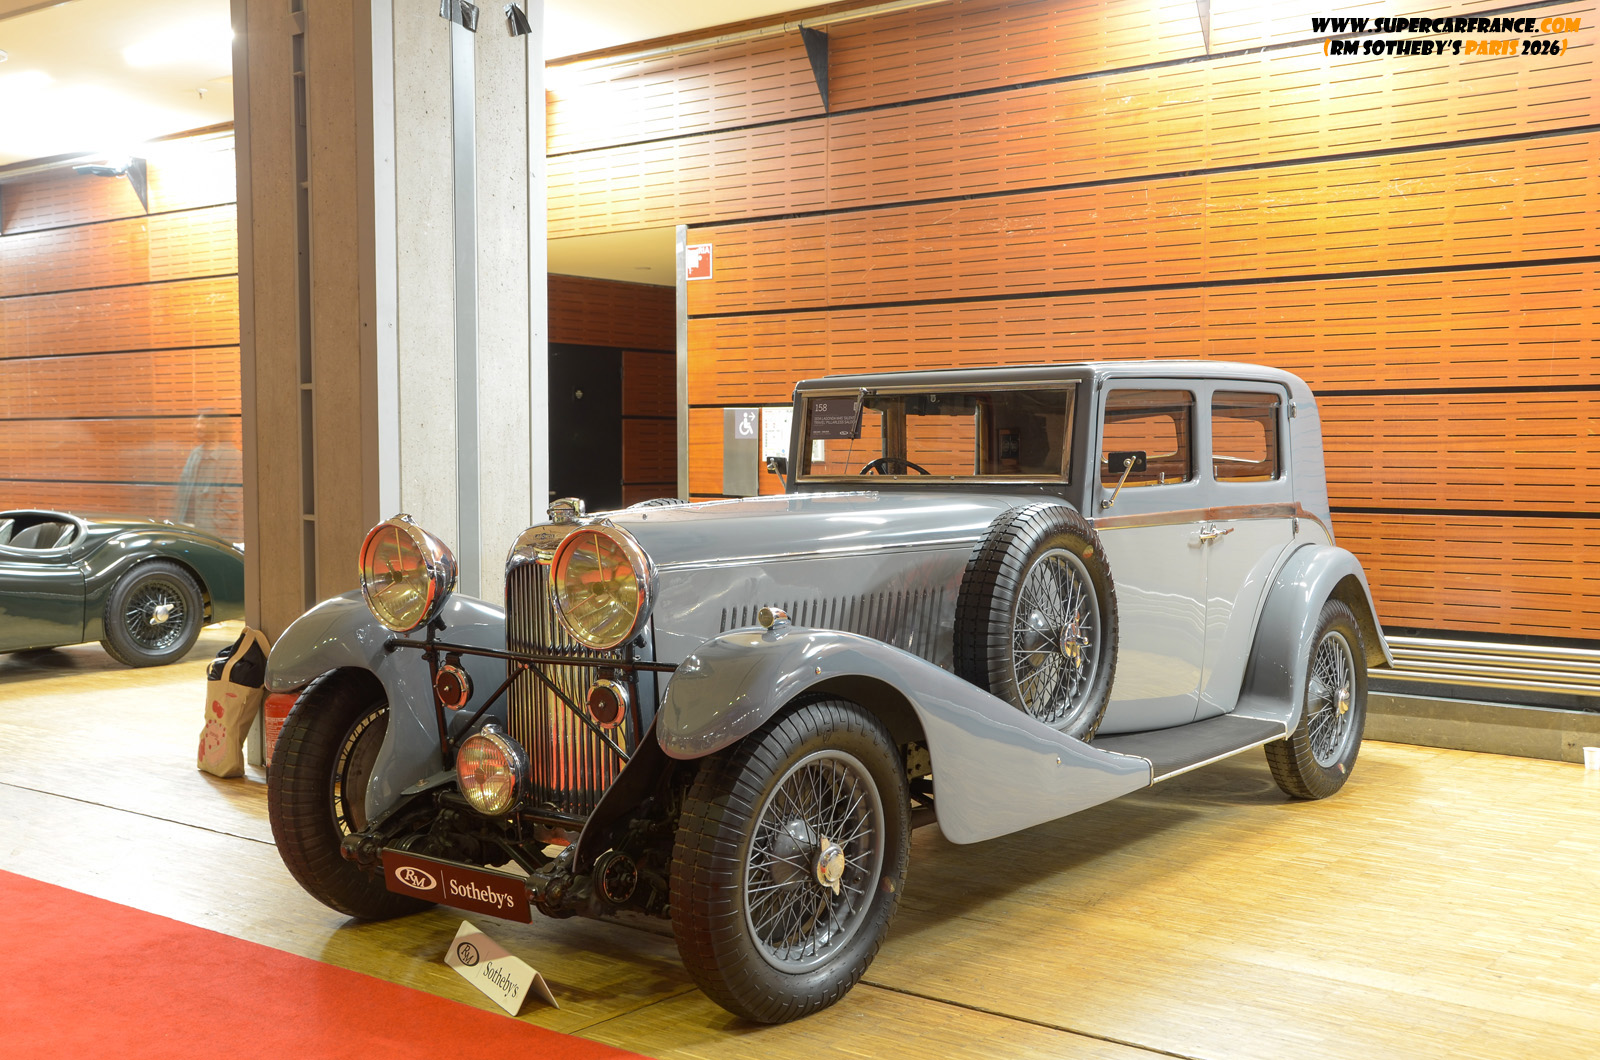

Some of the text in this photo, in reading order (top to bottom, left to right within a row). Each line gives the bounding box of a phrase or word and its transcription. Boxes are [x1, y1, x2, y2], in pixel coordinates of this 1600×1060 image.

[815, 404, 828, 412] 158
[449, 878, 515, 909] Sotheby's
[482, 961, 520, 998] Sotheby's
